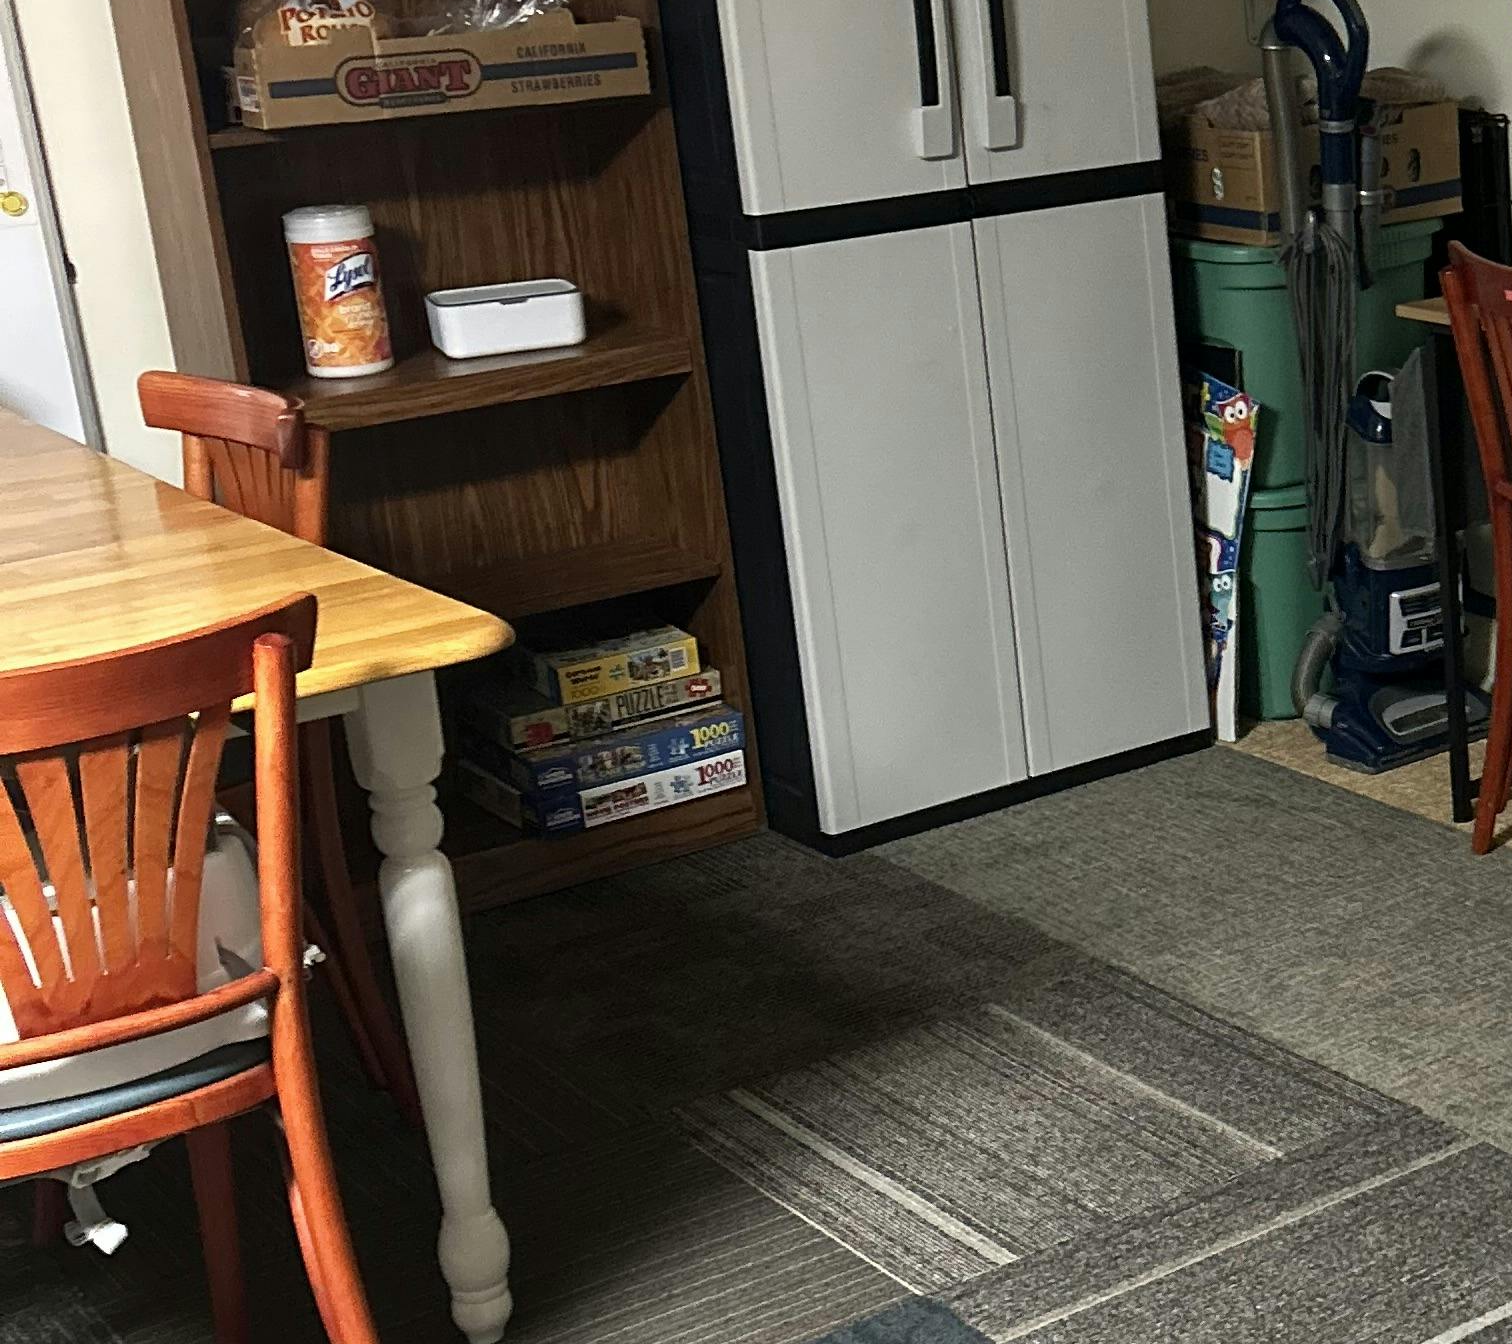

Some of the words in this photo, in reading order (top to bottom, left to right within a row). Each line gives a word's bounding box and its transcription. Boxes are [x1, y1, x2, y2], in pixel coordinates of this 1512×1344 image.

[516, 42, 587, 59] CALIFORNIA
[345, 59, 471, 100] GIANT
[511, 73, 602, 94] STRAWBERRIES
[328, 257, 370, 292] Lysol
[616, 685, 666, 718] PUZZLE
[689, 721, 730, 749] 1000
[695, 759, 734, 786] 1000
